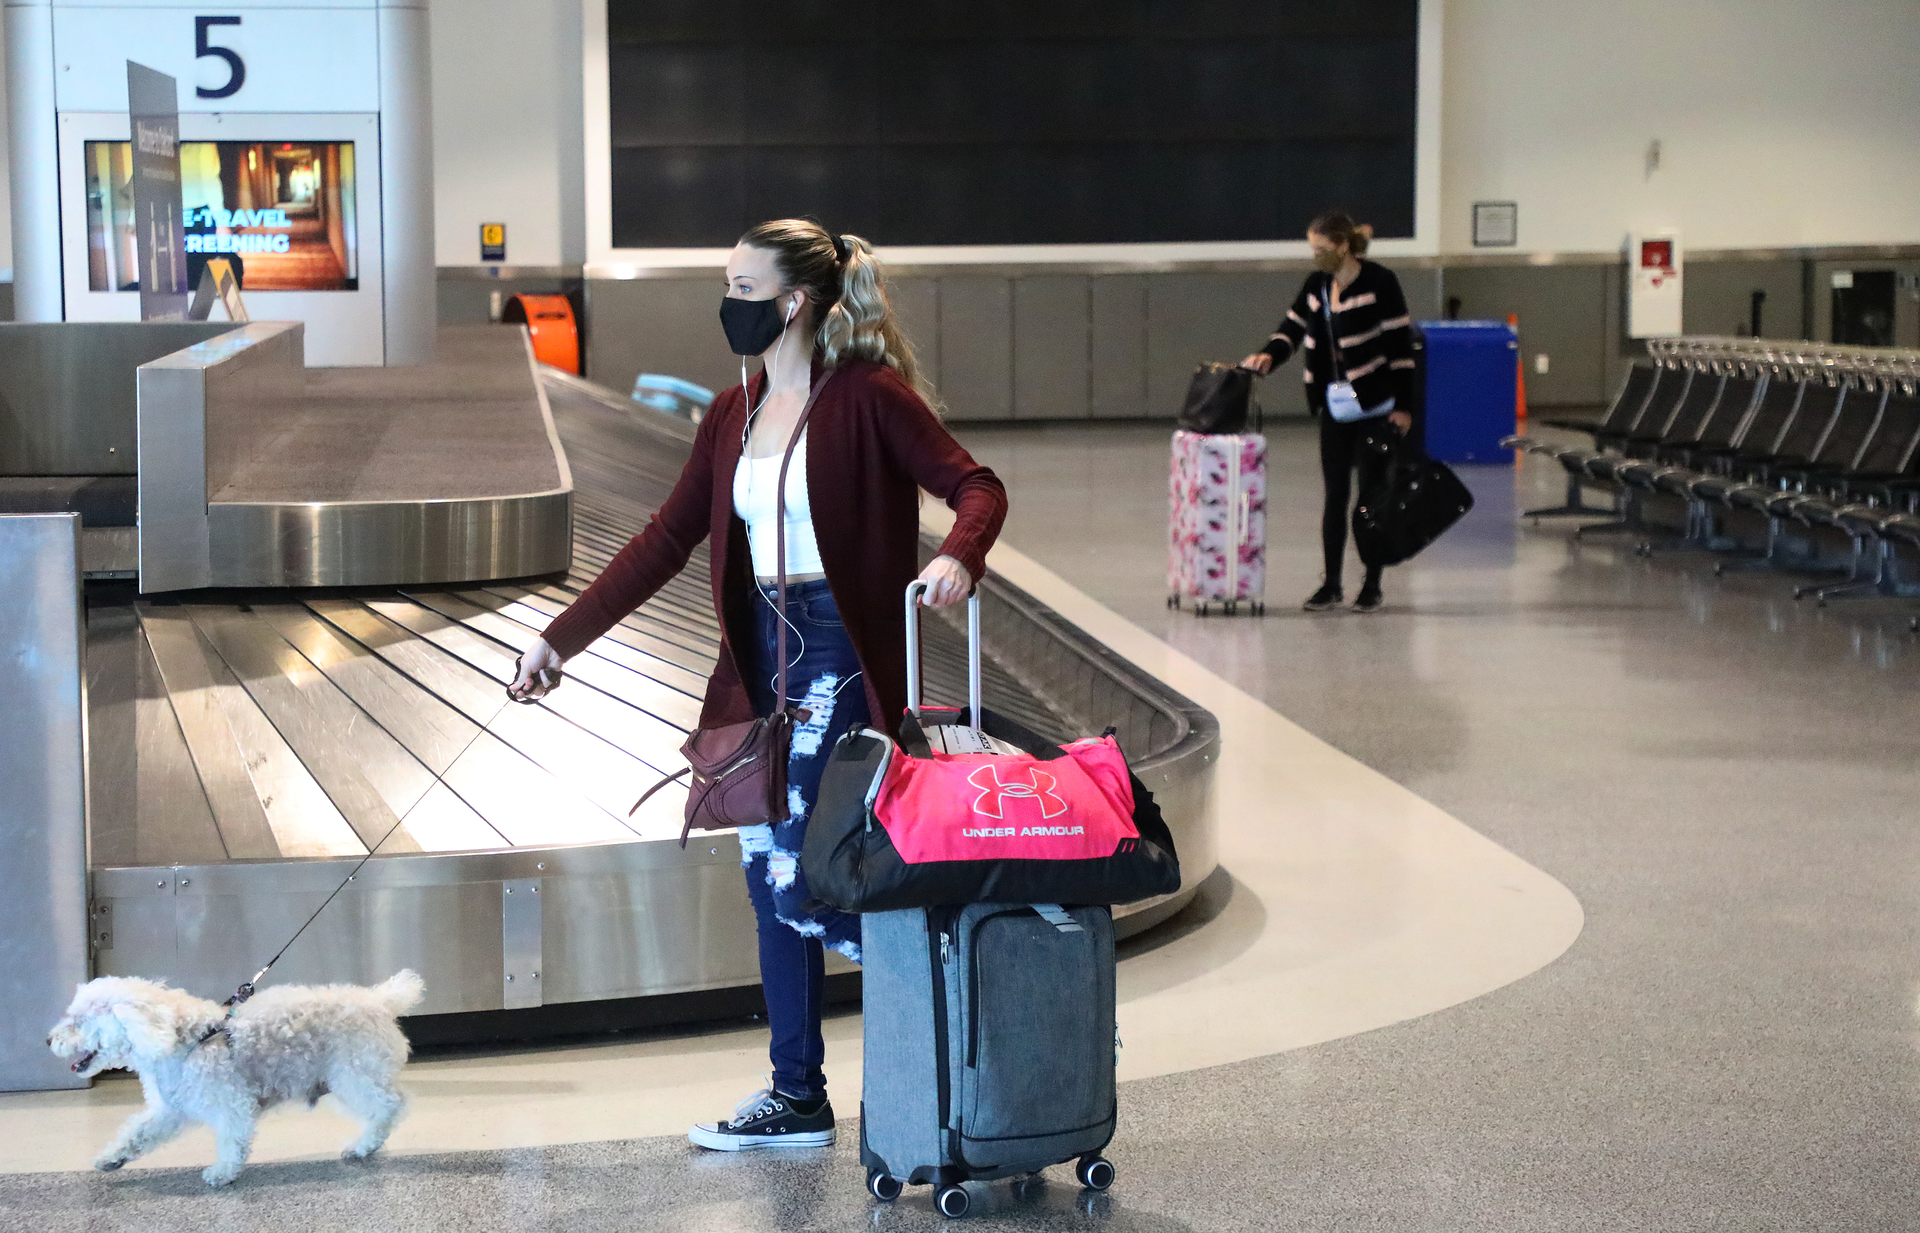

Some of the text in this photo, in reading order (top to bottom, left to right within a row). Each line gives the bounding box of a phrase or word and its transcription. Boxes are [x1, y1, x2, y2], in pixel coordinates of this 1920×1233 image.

[195, 16, 246, 99] 5
[184, 233, 290, 253] REENING
[962, 825, 1084, 838] UNDER ARMOUR
